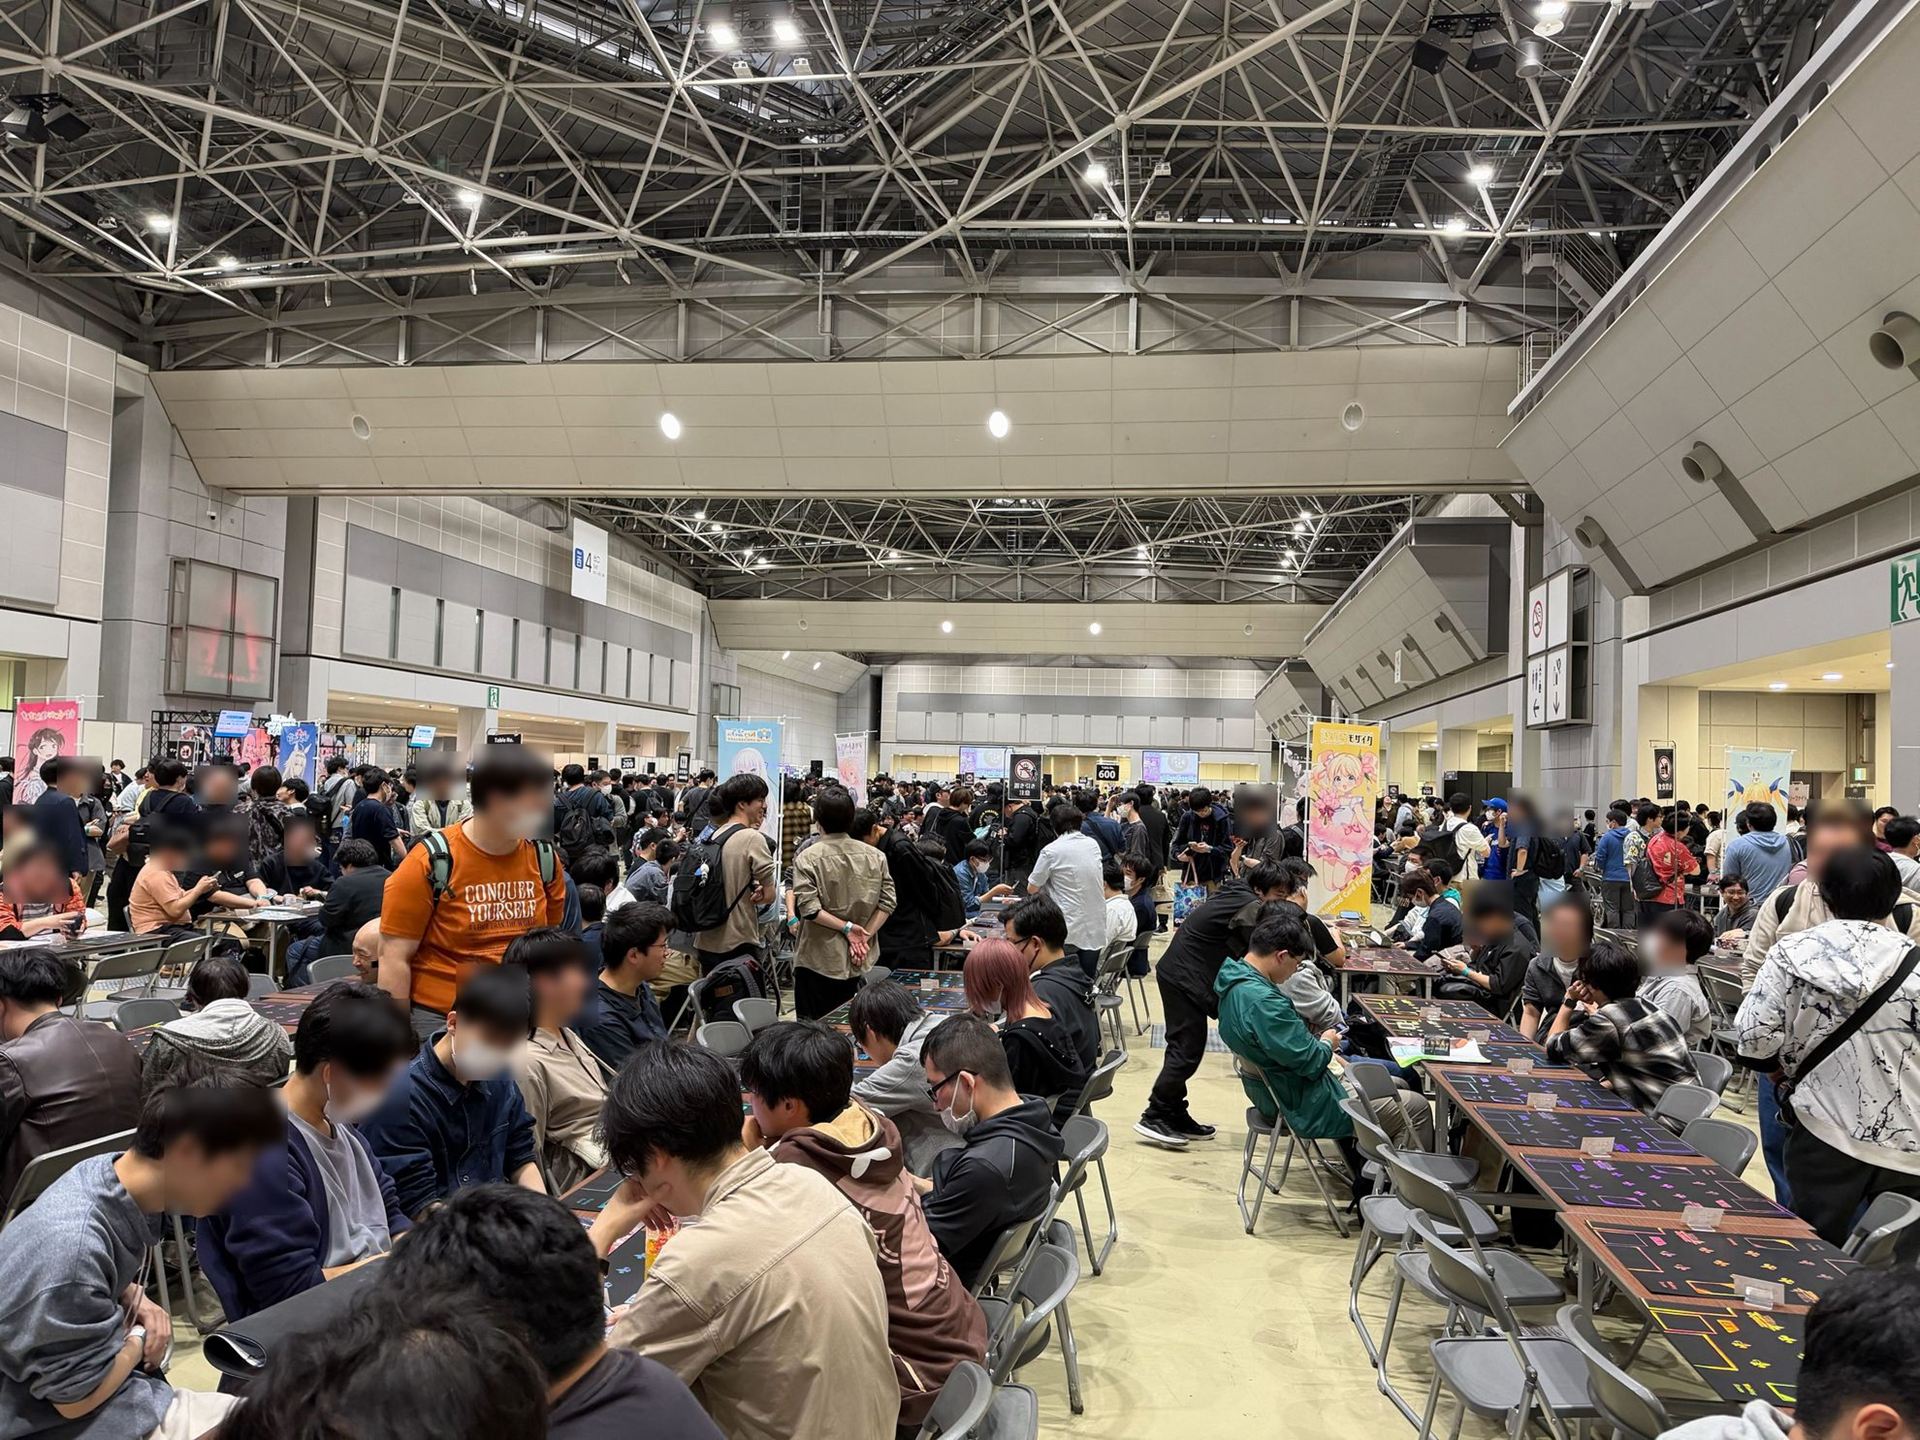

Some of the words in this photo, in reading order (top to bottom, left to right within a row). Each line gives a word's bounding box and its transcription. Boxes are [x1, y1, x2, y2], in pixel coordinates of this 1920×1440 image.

[585, 552, 592, 573] 4
[1098, 769, 1116, 779] 600
[464, 880, 535, 904] CONQUER
[467, 899, 537, 923] YOURSELF
